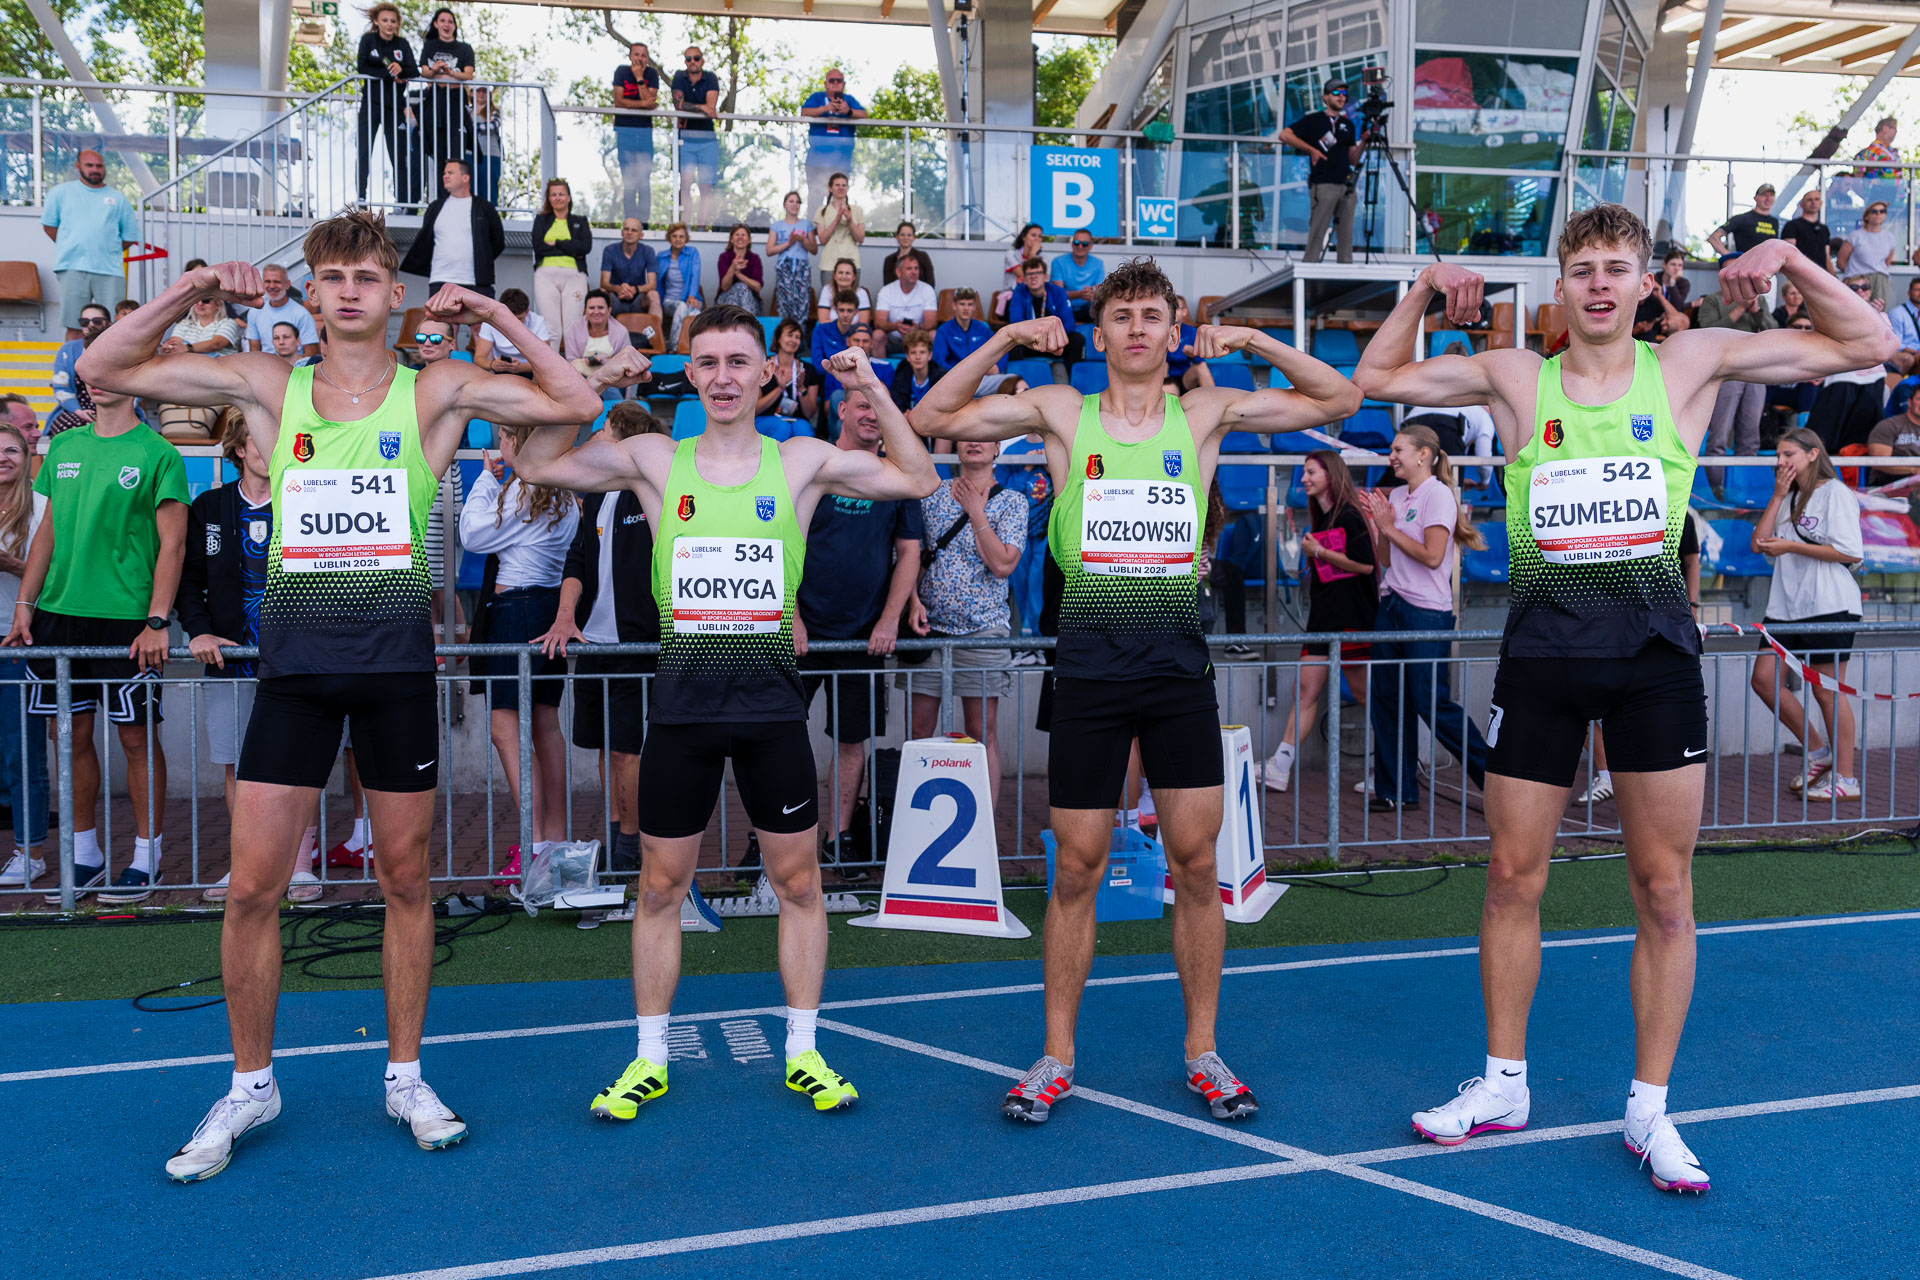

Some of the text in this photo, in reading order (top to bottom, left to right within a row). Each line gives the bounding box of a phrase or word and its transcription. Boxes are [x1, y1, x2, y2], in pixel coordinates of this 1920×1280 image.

[1046, 153, 1101, 168] SEKTOR
[1052, 171, 1096, 229] B
[1140, 203, 1174, 222] WC
[1550, 462, 1651, 482] LUBELSKIE 542
[351, 475, 396, 494] 541
[1147, 486, 1186, 505] 535
[1535, 497, 1660, 529] SZUMEŁDA
[300, 512, 390, 535] SUDOŁ
[1087, 520, 1191, 542] KOZŁOWSKI
[734, 543, 774, 563] 534
[1564, 549, 1632, 561] LUBLIN 2026
[314, 559, 380, 569] LUBLIN 2026
[678, 578, 777, 599] KORYGA
[732, 623, 755, 631] 2026
[931, 757, 972, 769] polanik
[1239, 760, 1255, 862] 1
[907, 777, 977, 888] 2
[720, 1019, 774, 1064] 10000
